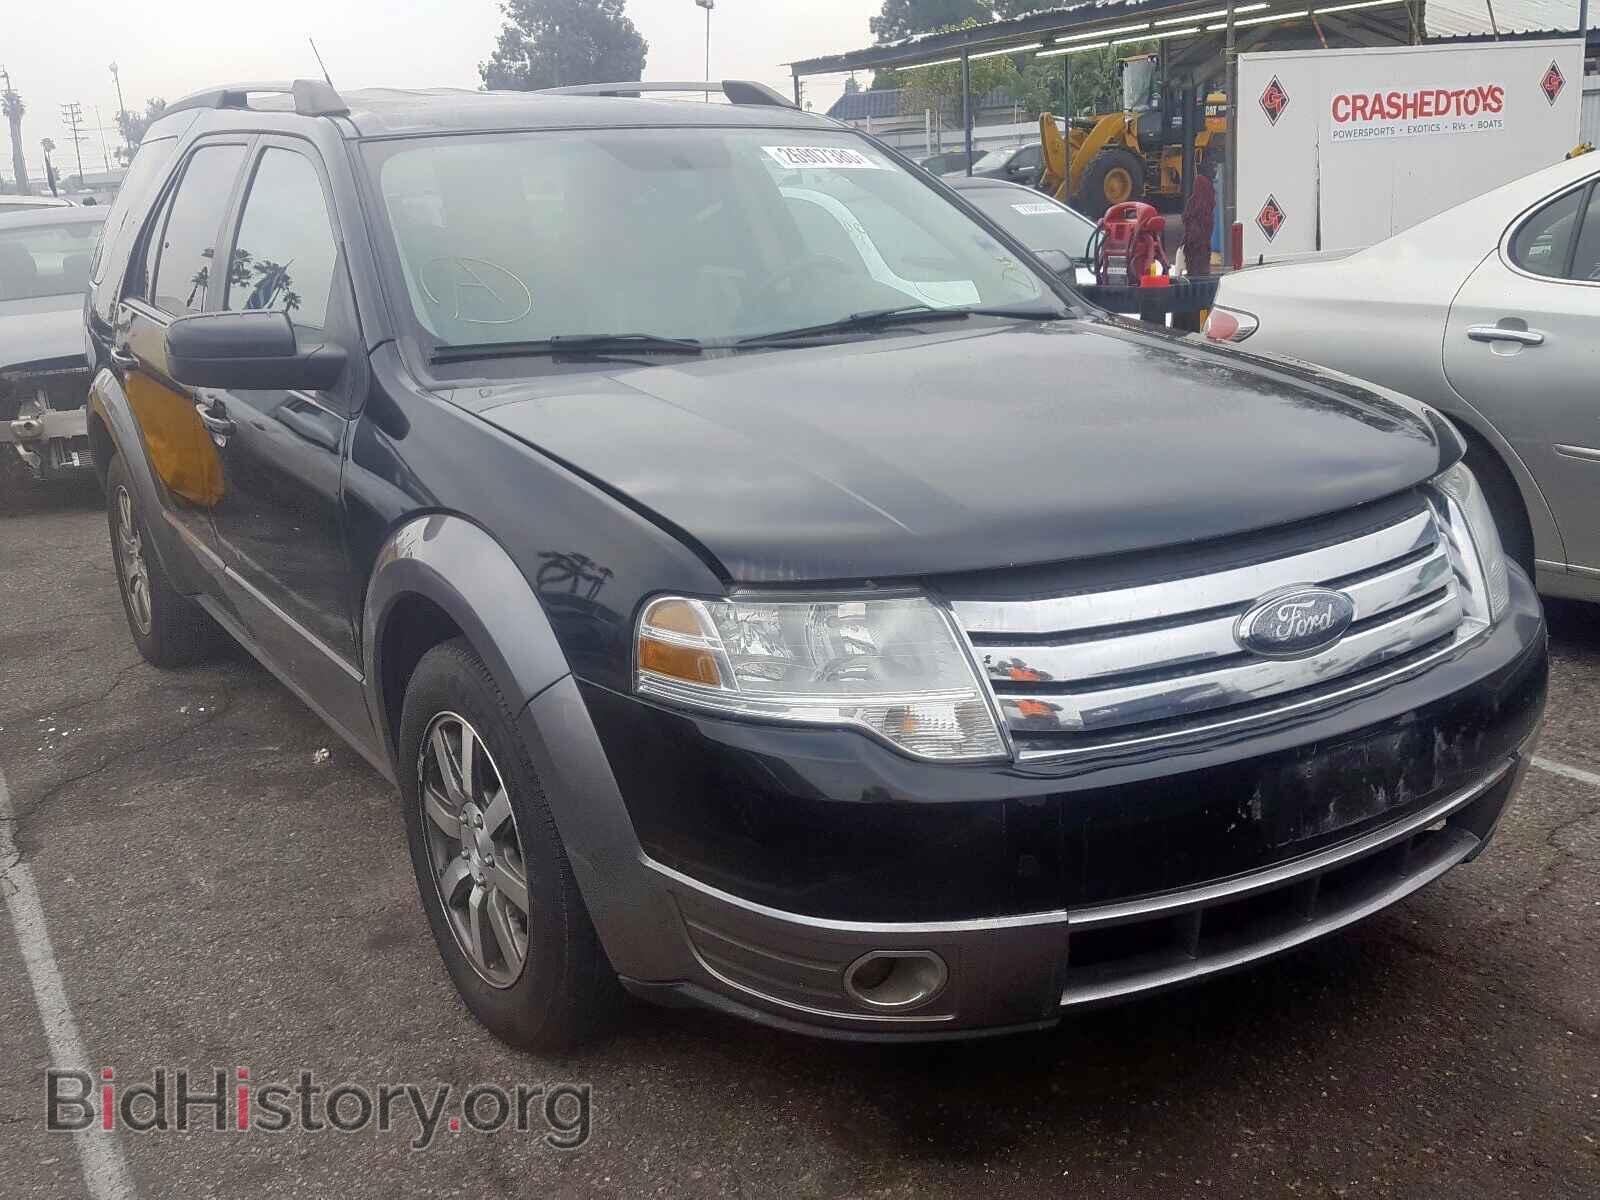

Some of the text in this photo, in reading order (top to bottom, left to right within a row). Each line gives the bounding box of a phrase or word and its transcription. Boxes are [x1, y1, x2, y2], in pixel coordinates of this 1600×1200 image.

[1332, 85, 1505, 123] CRASHEDTOYS
[1332, 126, 1396, 139] POWERSPORTS
[1407, 123, 1441, 134] EXOTICS
[1478, 119, 1503, 129] BOATS
[1276, 599, 1335, 640] Ford
